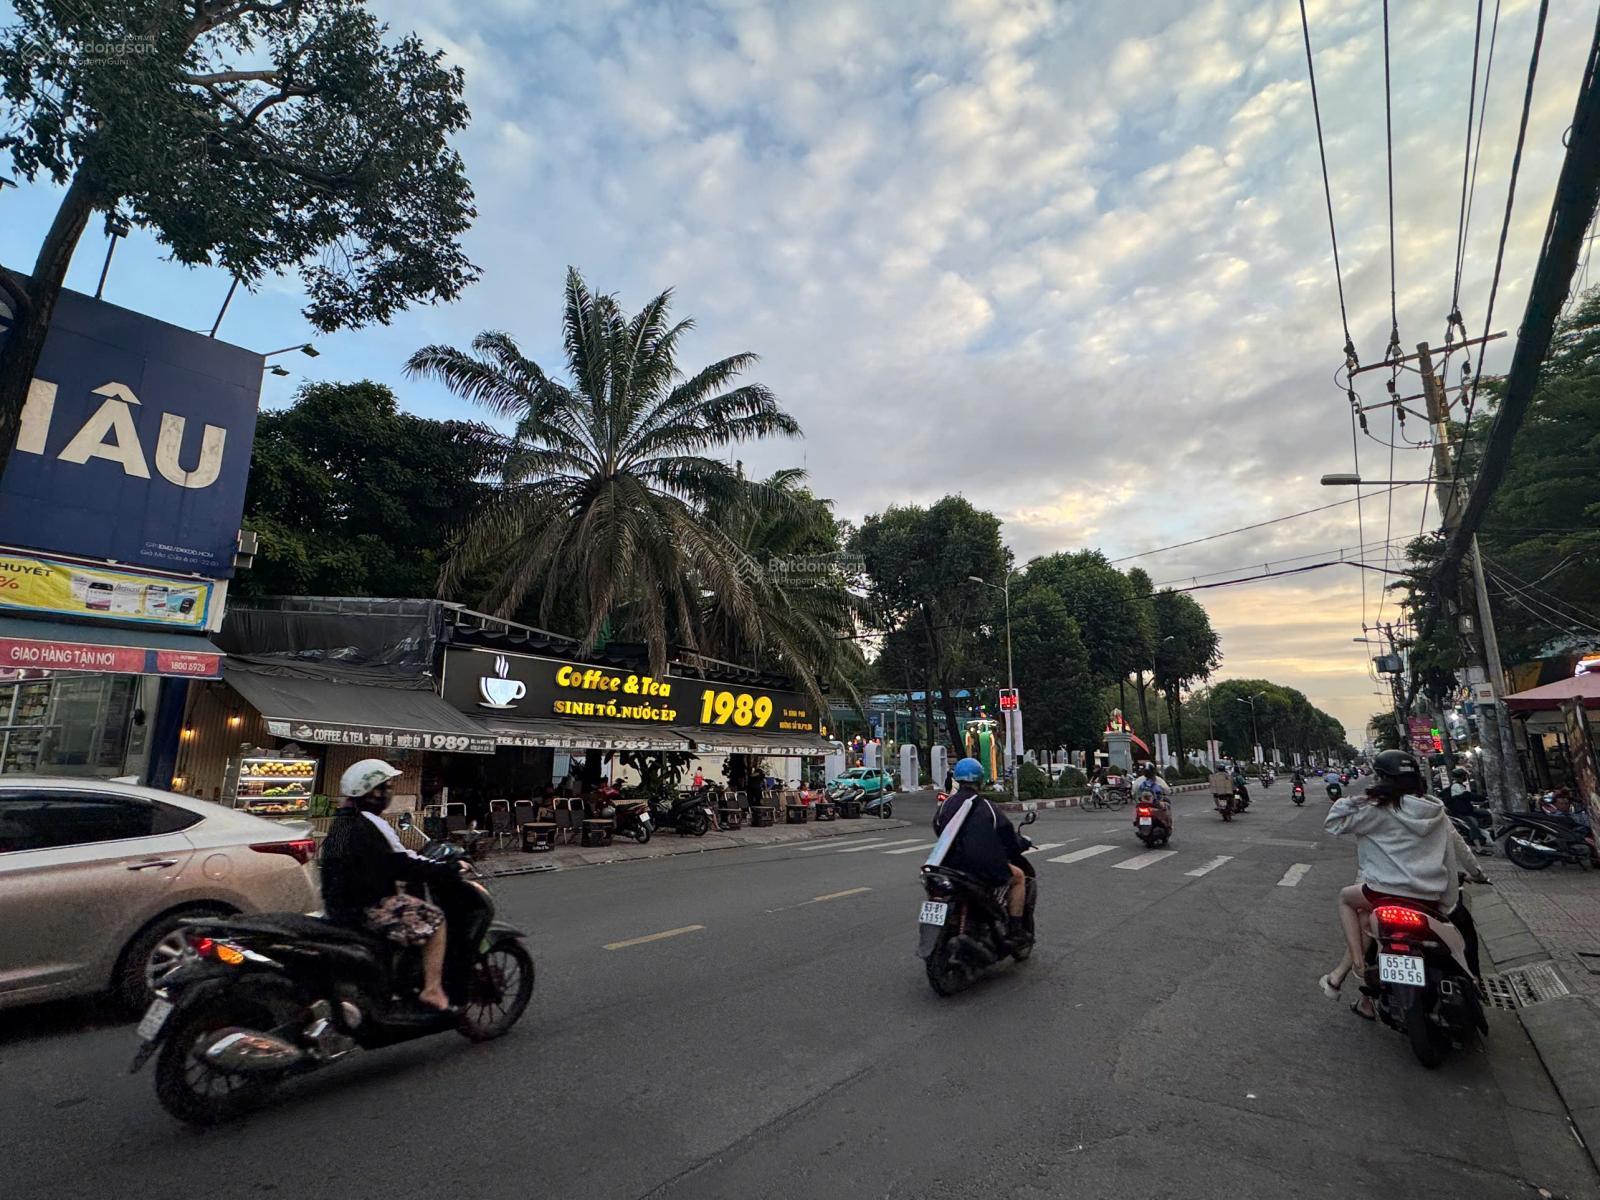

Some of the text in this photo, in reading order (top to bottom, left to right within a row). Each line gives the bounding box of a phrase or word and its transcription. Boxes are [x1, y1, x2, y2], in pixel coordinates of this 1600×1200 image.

[10, 645, 115, 668] GIAO HÀNG TẬN NƠI
[171, 661, 206, 672] 1800 6928
[555, 665, 671, 697] Coffee & Tea
[553, 700, 595, 716] SINH
[700, 689, 773, 728] 1989
[313, 728, 342, 742] COFFEE
[349, 731, 363, 744] TEA
[422, 733, 470, 750] 1989
[603, 739, 650, 750] 1989
